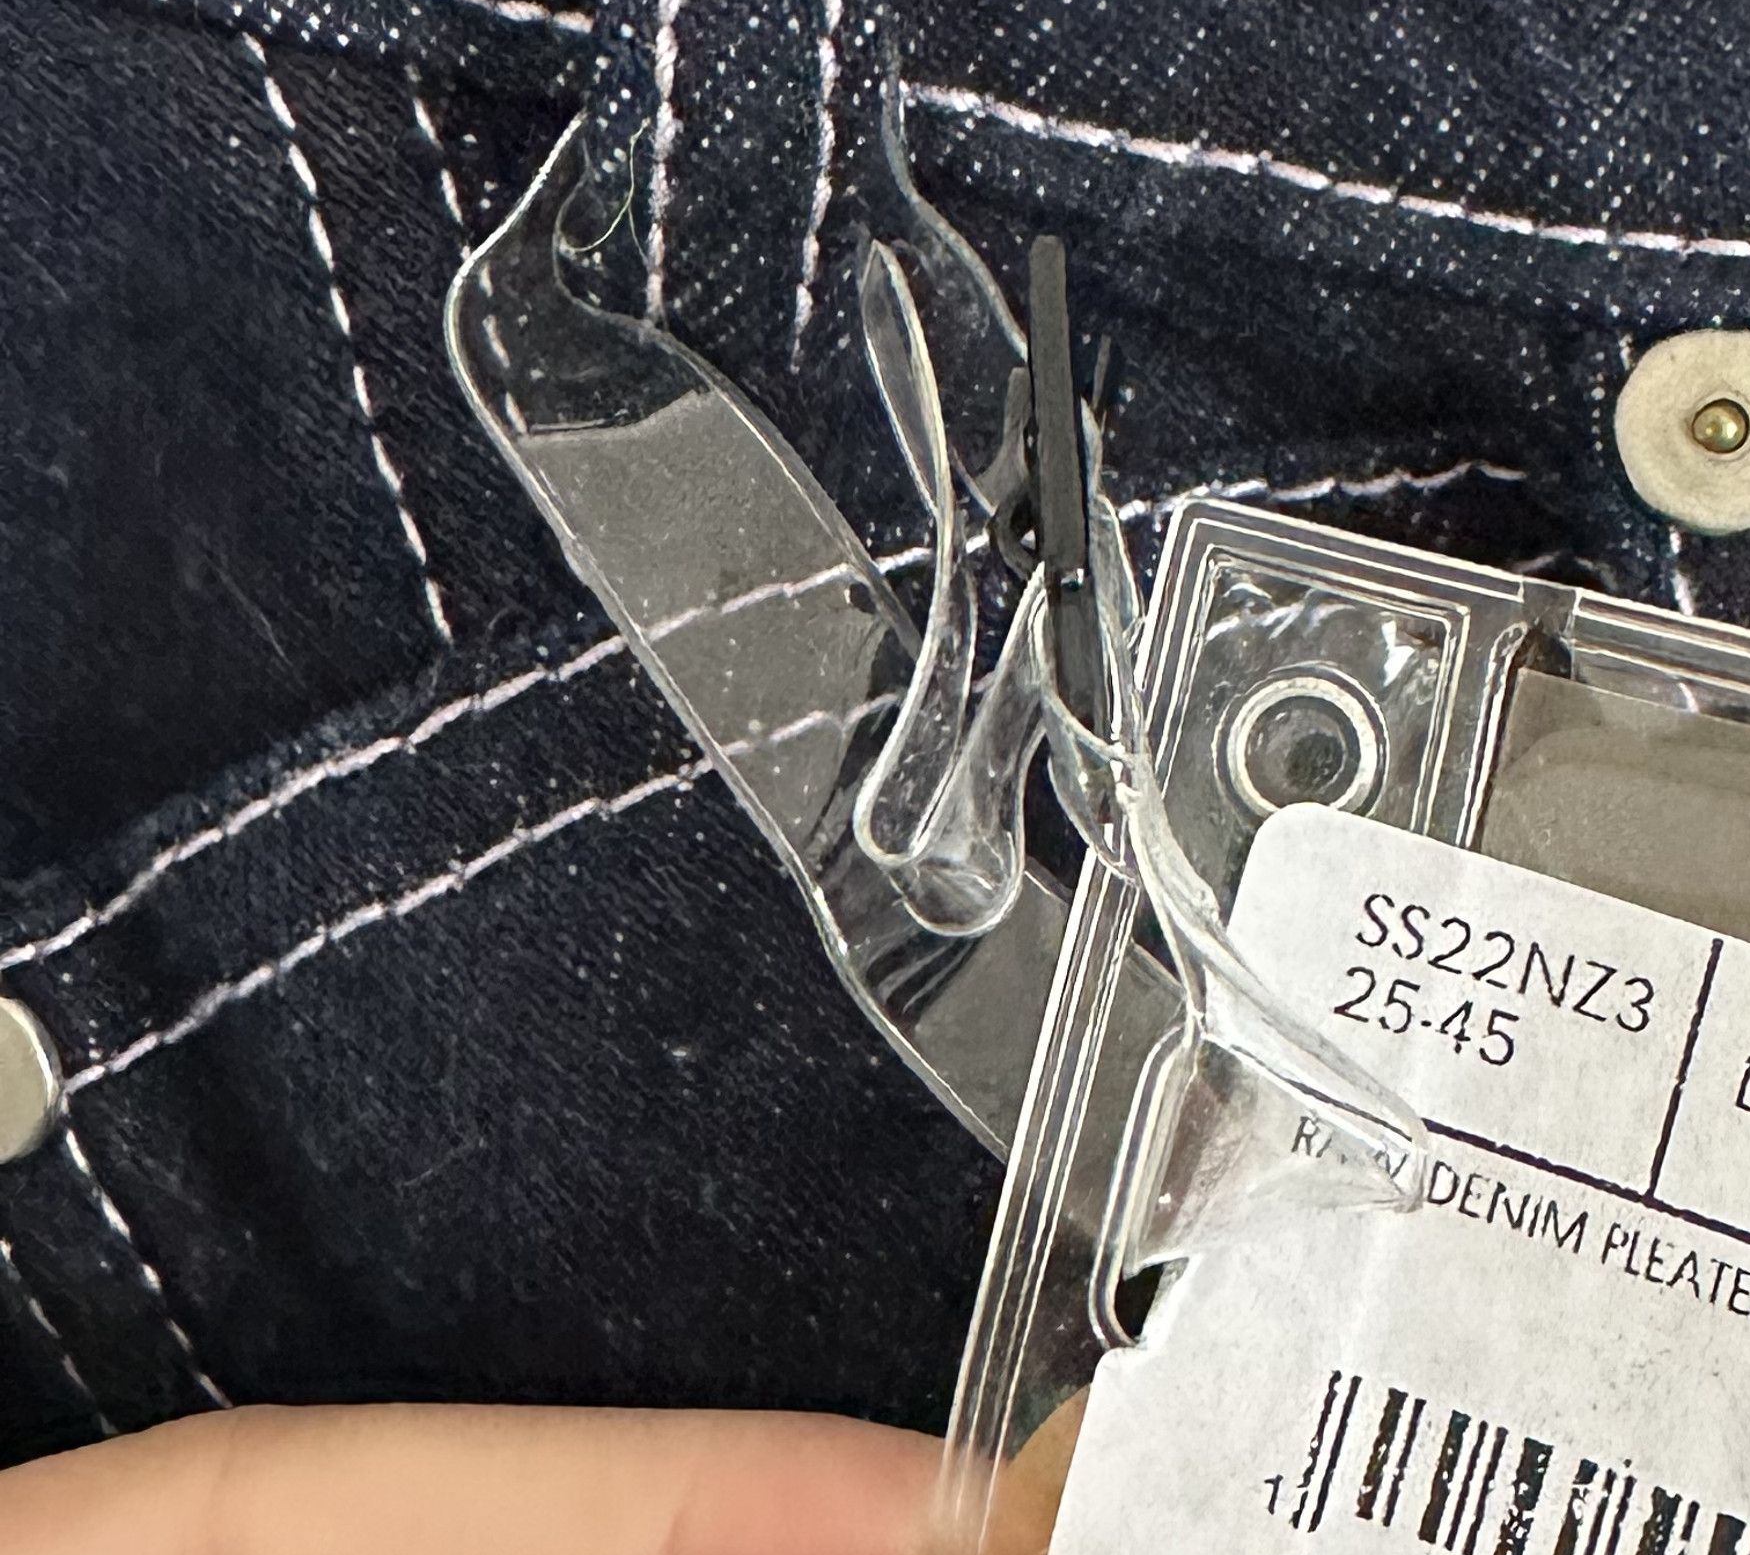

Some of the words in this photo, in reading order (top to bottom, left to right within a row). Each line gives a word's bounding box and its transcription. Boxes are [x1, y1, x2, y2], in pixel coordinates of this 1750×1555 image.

[1355, 893, 1656, 1033] SS22NZ3
[1332, 965, 1520, 1066] 25-45
[1426, 1160, 1588, 1254] DENIM
